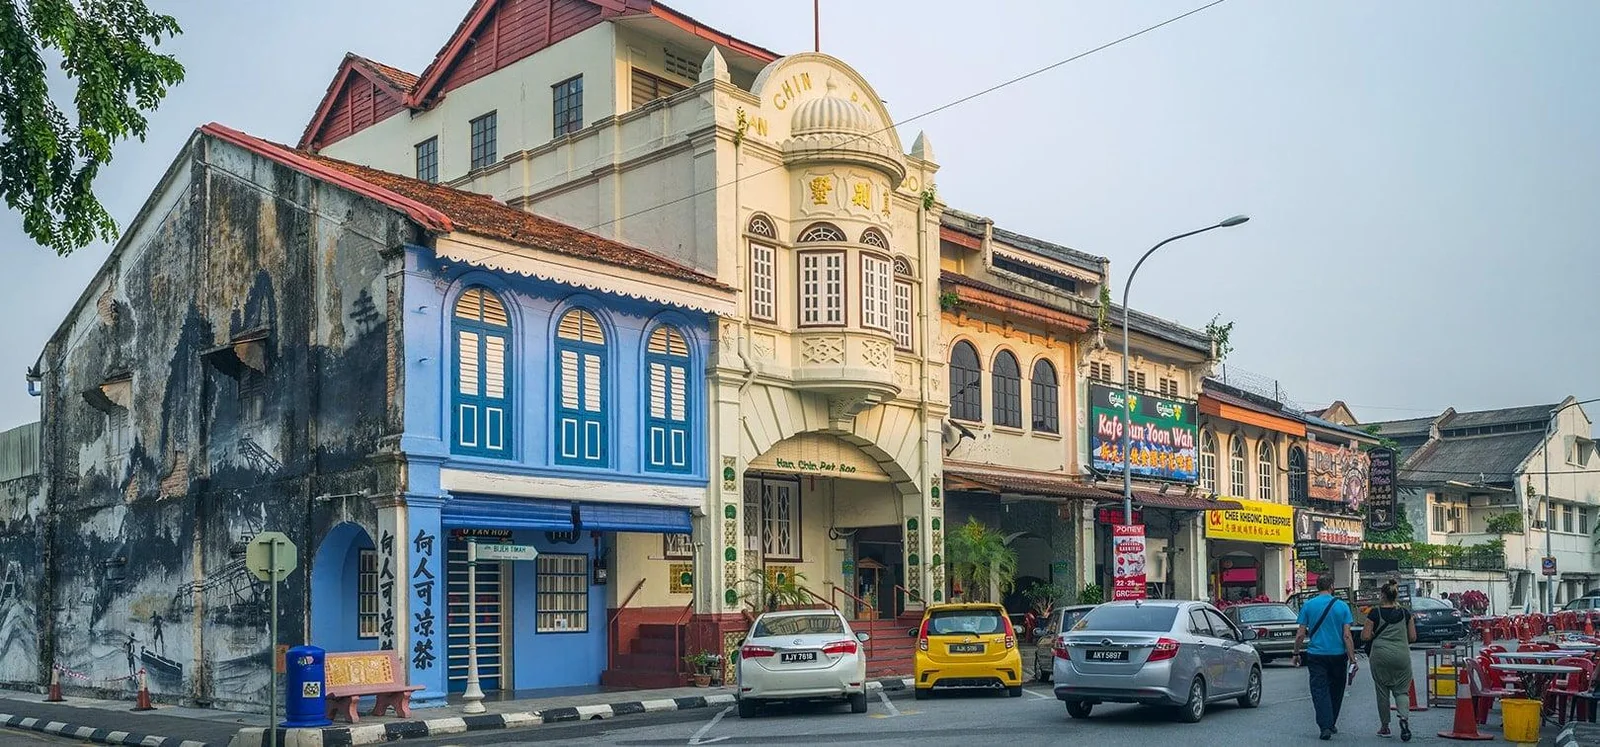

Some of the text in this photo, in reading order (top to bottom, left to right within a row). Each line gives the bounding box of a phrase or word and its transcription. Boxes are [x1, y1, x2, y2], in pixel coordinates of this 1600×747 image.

[773, 71, 812, 111] CHIN
[1098, 414, 1123, 440] Kafe
[1147, 423, 1170, 445] Yoon
[1172, 427, 1193, 448] Wah
[776, 458, 856, 473] Han Chin Pet Soo
[1225, 511, 1291, 527] CHEE KHEONG ENTERPRISE
[1105, 651, 1121, 659] 5897
